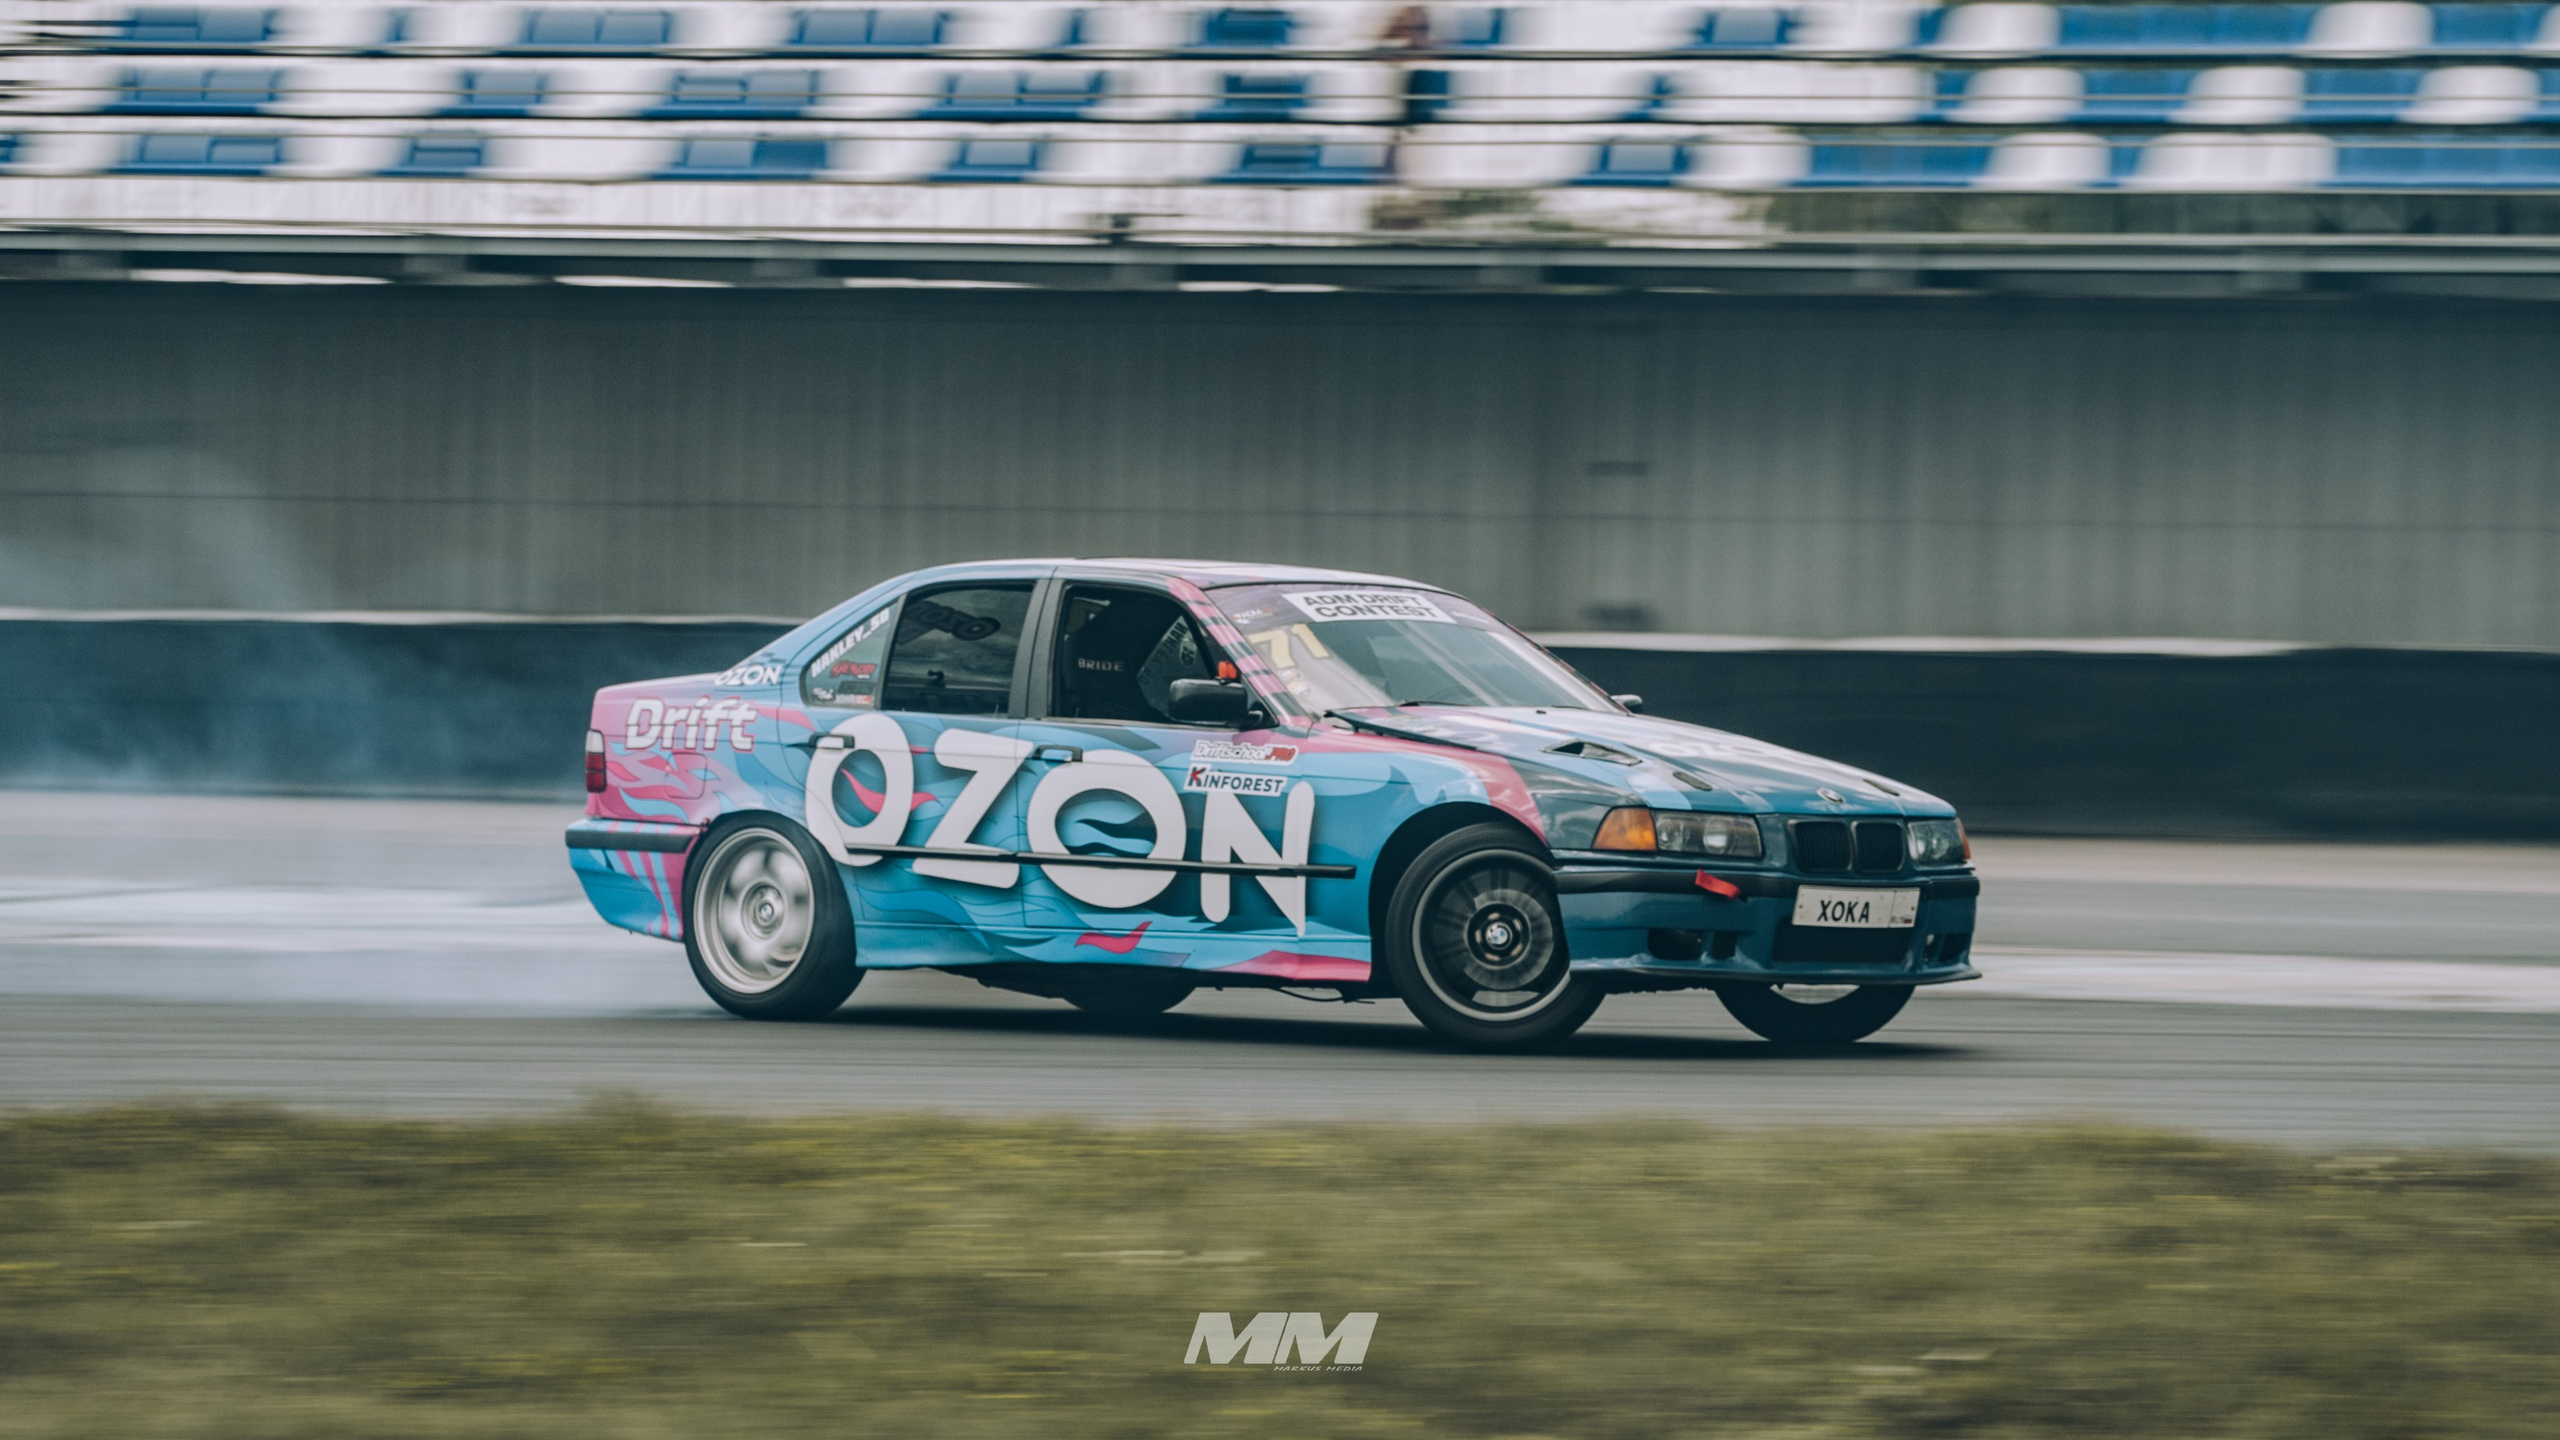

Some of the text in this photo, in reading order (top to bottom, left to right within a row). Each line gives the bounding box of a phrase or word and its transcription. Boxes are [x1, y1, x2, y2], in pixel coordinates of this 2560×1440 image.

[1303, 594, 1422, 606] ADM DRIFT
[1315, 604, 1437, 618] CONTEST
[1246, 622, 1333, 669] 71
[714, 663, 784, 686] OZON
[1077, 657, 1125, 672] BRIDE
[624, 694, 759, 751] Drift
[1187, 766, 1284, 793] KINFOREST
[804, 712, 1316, 937] OZON
[1816, 899, 1870, 924] XOKA
